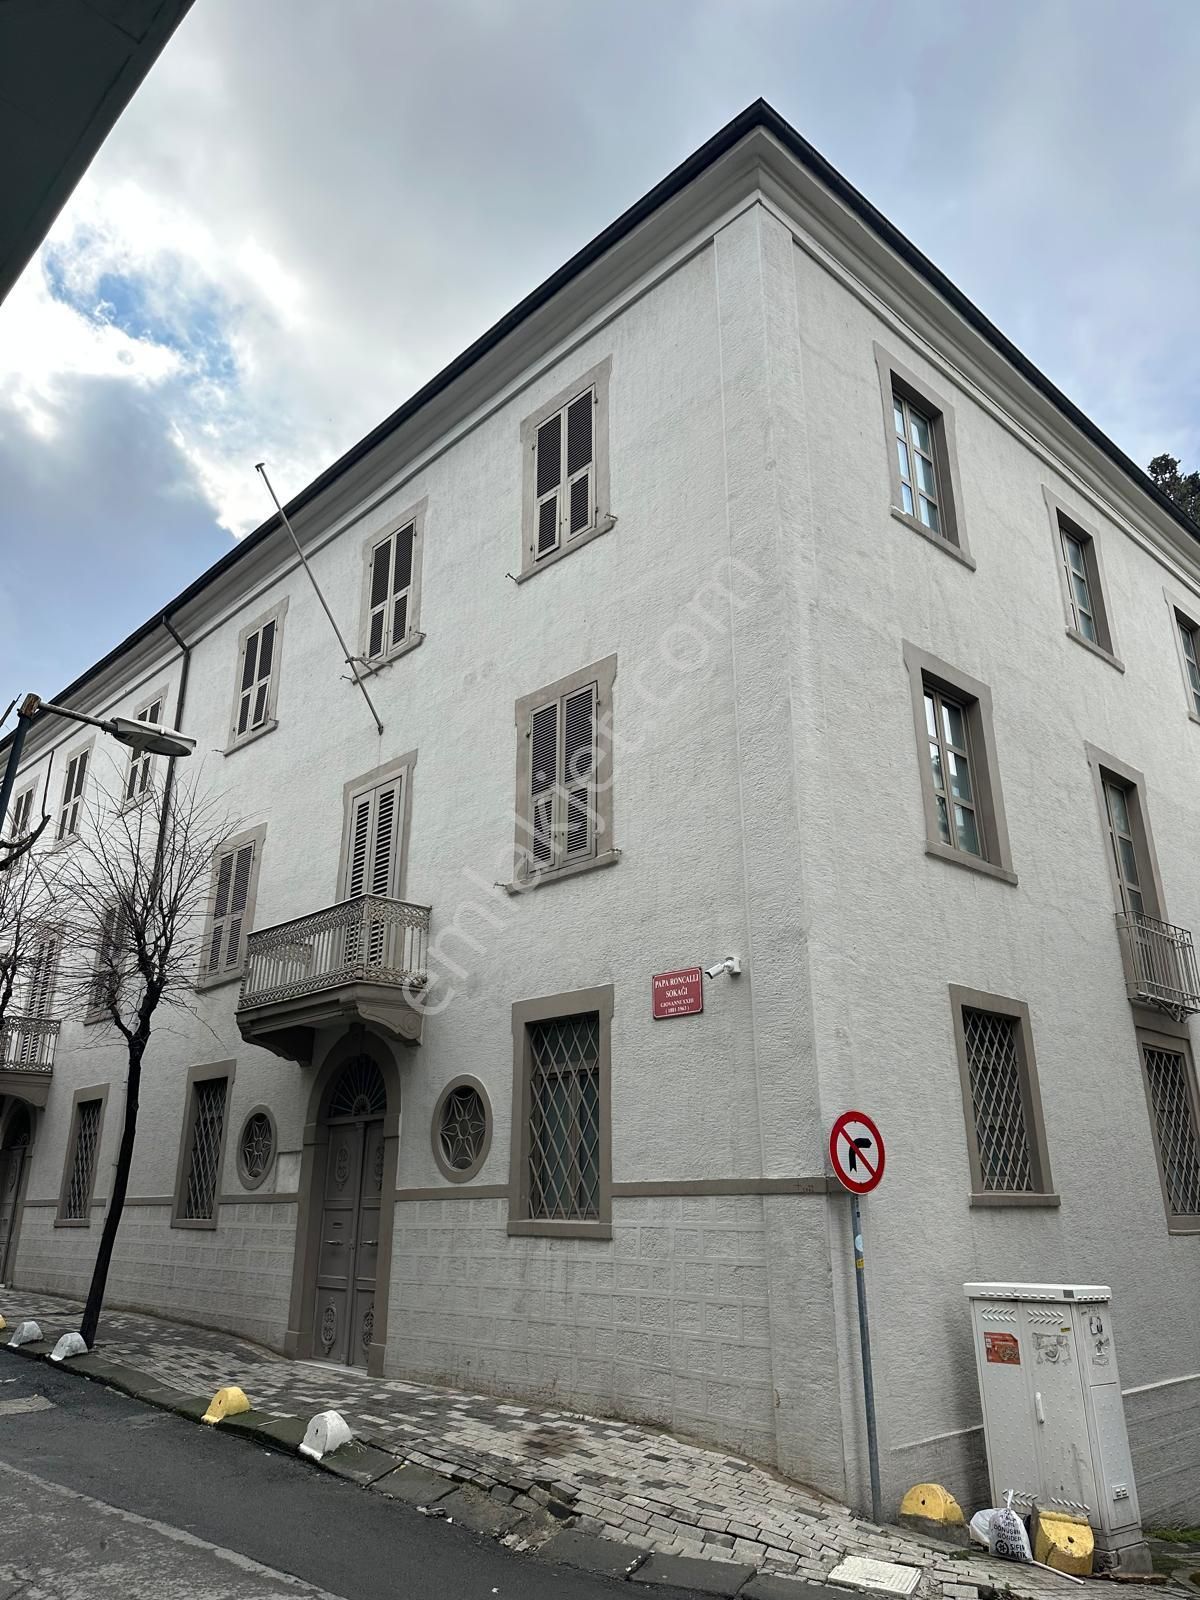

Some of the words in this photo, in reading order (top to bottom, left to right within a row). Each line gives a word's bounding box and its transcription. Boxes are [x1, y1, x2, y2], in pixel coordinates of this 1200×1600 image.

[655, 979, 669, 988] PAPA
[670, 974, 699, 985] RONCALLI
[665, 986, 688, 998] SOKAĞI
